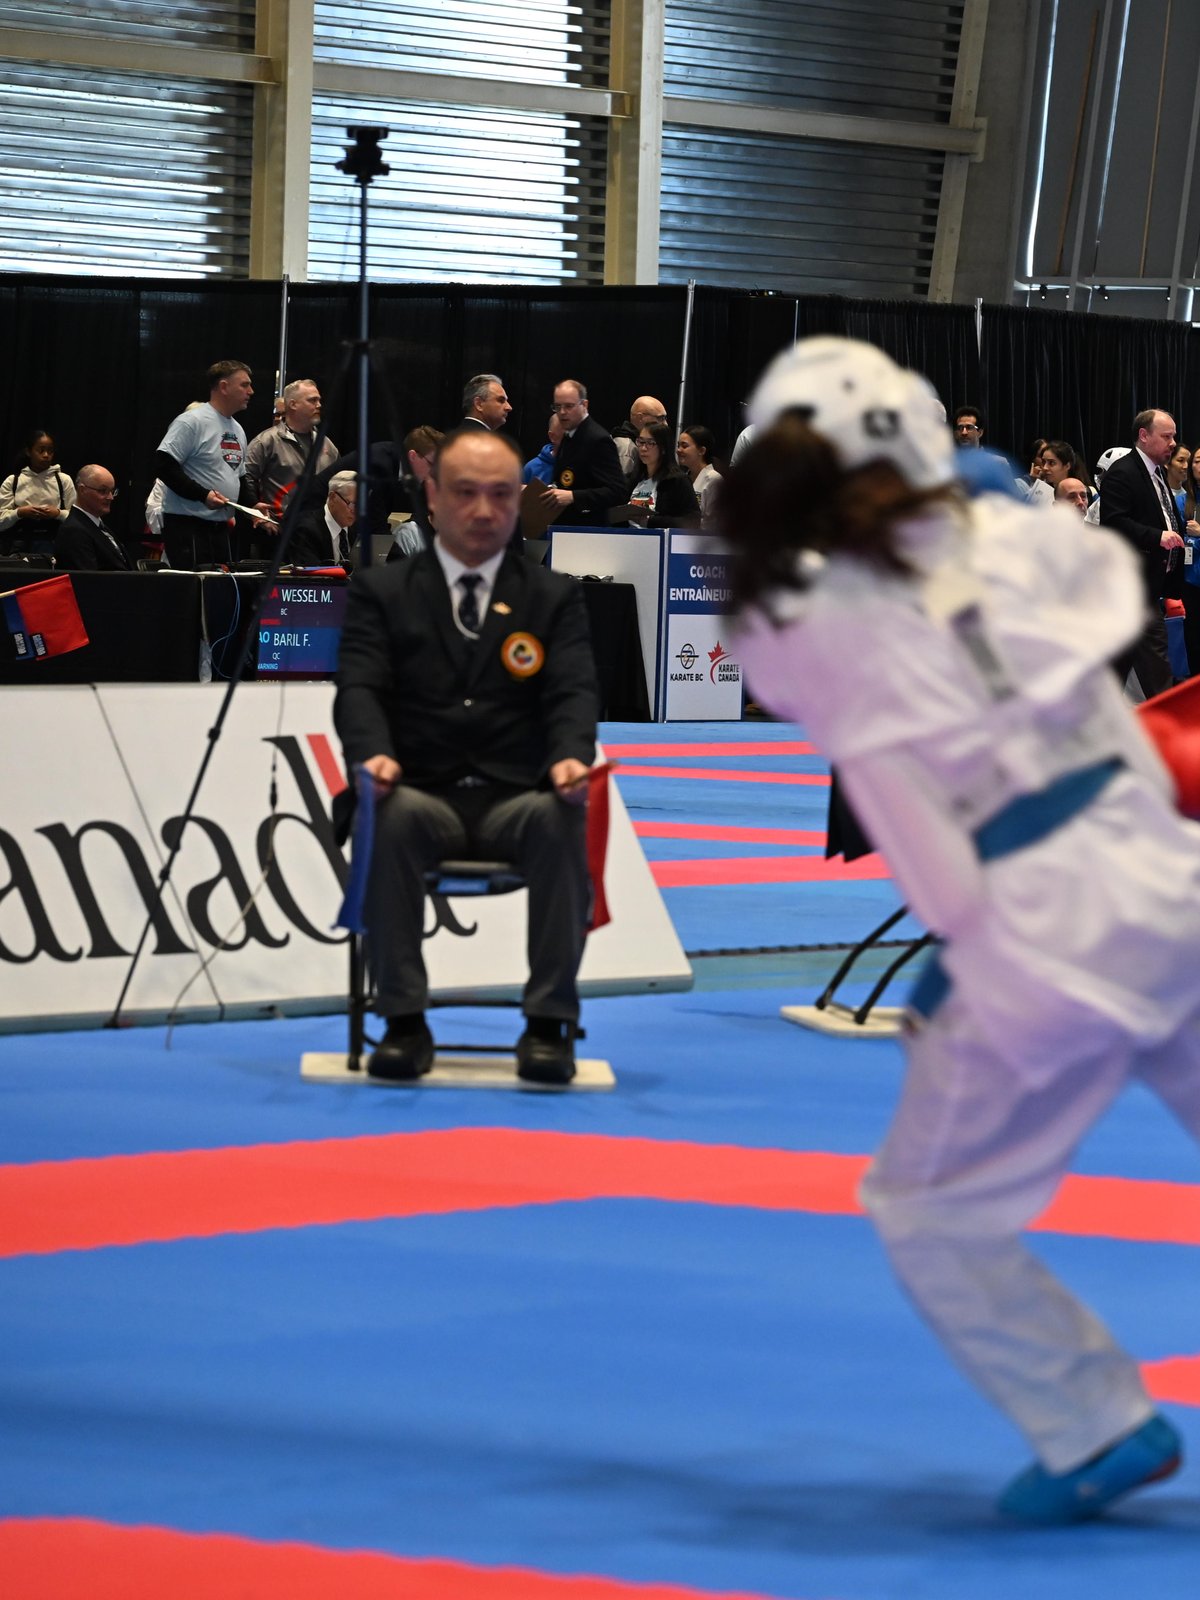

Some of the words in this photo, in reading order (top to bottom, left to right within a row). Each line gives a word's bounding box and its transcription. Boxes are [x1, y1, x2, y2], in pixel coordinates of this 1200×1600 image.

[690, 565, 726, 578] COACH
[281, 588, 318, 603] WESSEL
[321, 589, 333, 603] M.
[280, 607, 288, 616] BC
[273, 633, 300, 647] BARIL
[303, 633, 311, 647] F.
[272, 652, 280, 660] QC
[718, 664, 740, 673] KARATE
[670, 673, 694, 682] KARATE
[695, 673, 704, 682] BC
[718, 673, 740, 682] CANADA
